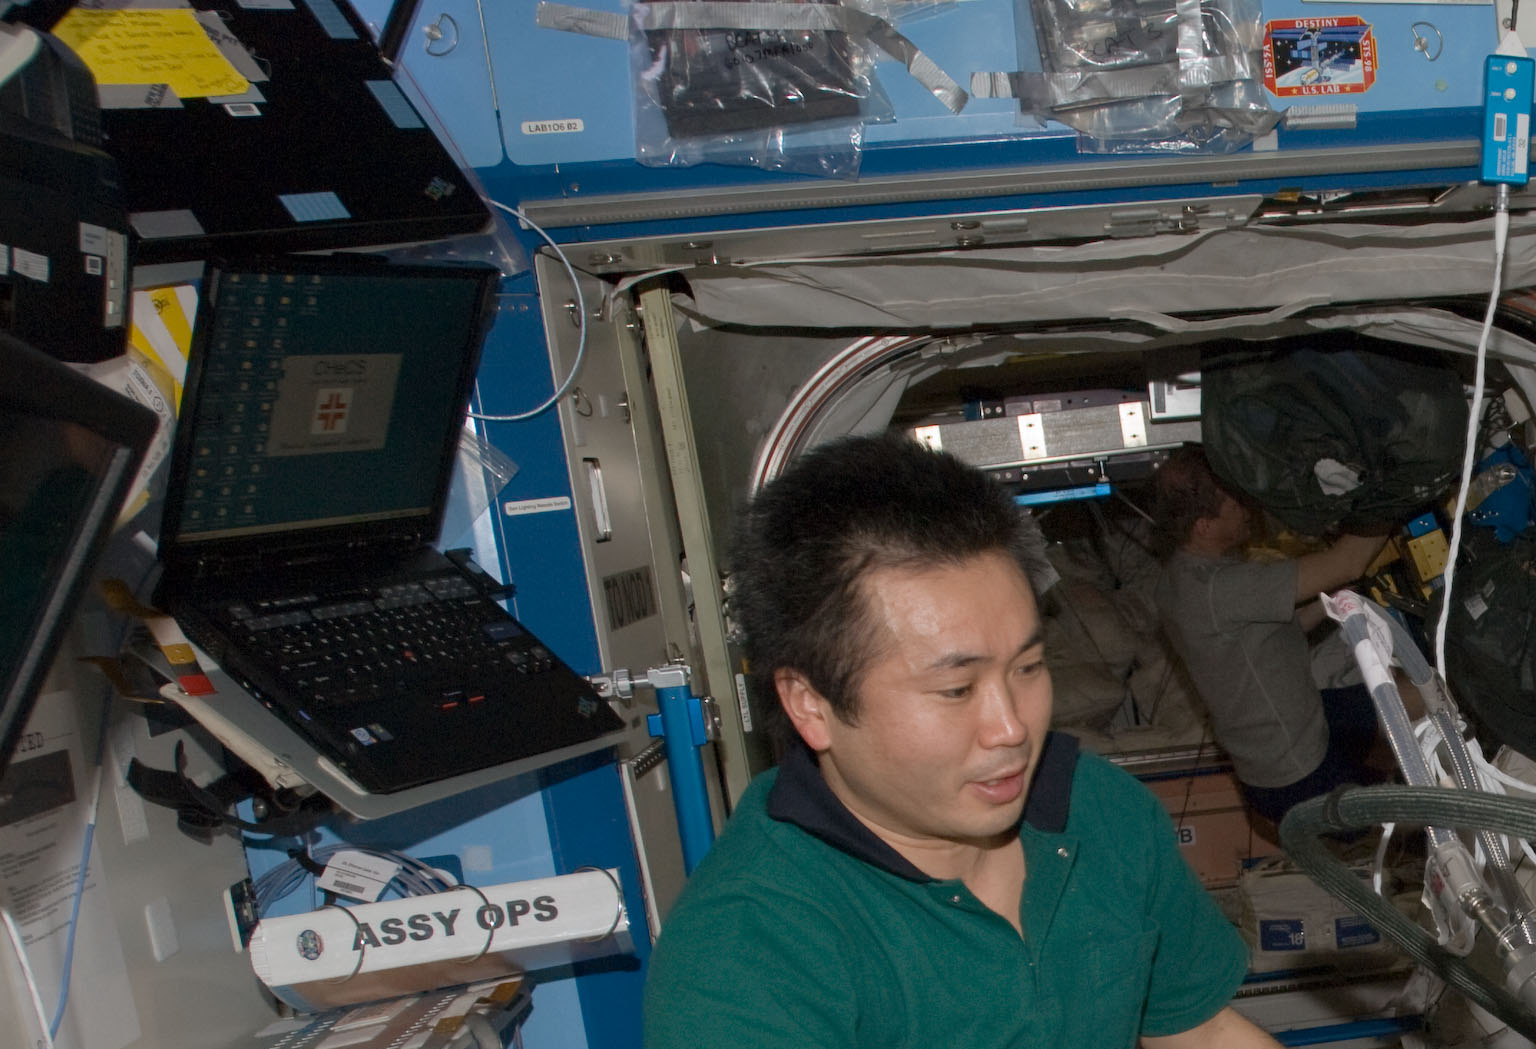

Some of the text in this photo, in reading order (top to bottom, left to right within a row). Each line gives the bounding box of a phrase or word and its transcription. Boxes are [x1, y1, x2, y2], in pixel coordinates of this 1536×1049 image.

[1295, 18, 1339, 28] DESTINY
[1302, 84, 1340, 94] U.S. LAB
[352, 896, 559, 950] ASSY OPS
